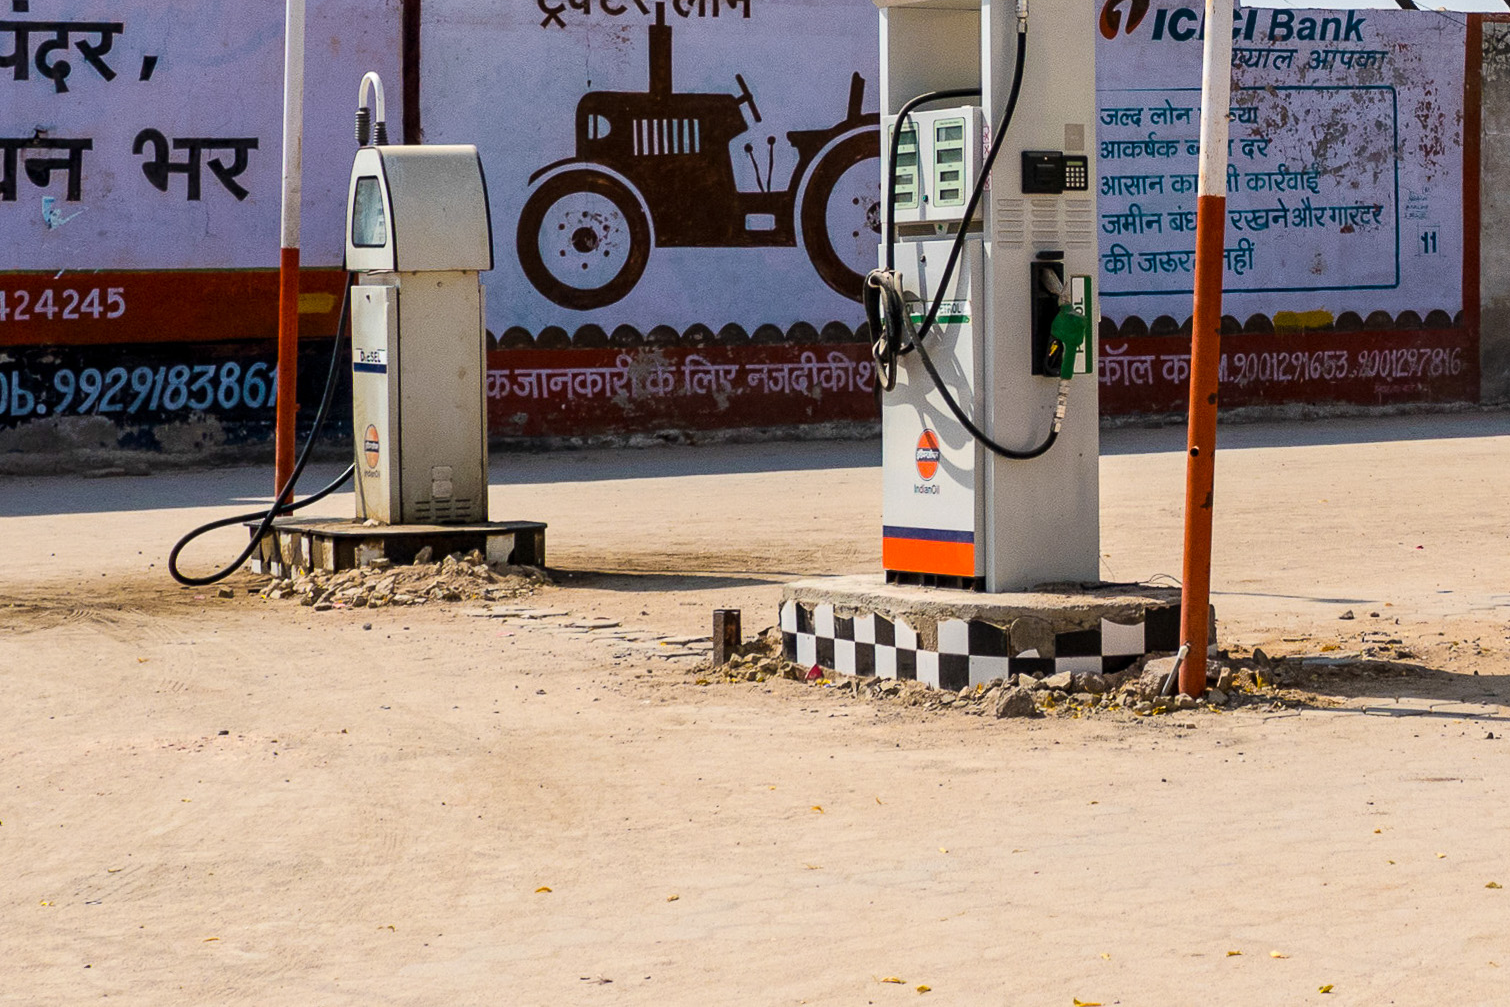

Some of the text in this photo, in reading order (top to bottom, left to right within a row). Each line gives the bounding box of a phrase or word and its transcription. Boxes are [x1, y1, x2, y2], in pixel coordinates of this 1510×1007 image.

[1267, 8, 1367, 42] Bank
[1307, 48, 1389, 72] आपका
[1100, 107, 1144, 127] जल्द
[1148, 98, 1194, 125] लोन
[1100, 131, 1180, 159] आकर्षक
[1239, 138, 1271, 160] दर
[132, 128, 259, 201] भर
[1100, 174, 1165, 196] आसान
[1101, 203, 1163, 235] जमीन
[1228, 198, 1290, 232] रखने
[1291, 196, 1328, 228] और
[1101, 243, 1132, 275] की
